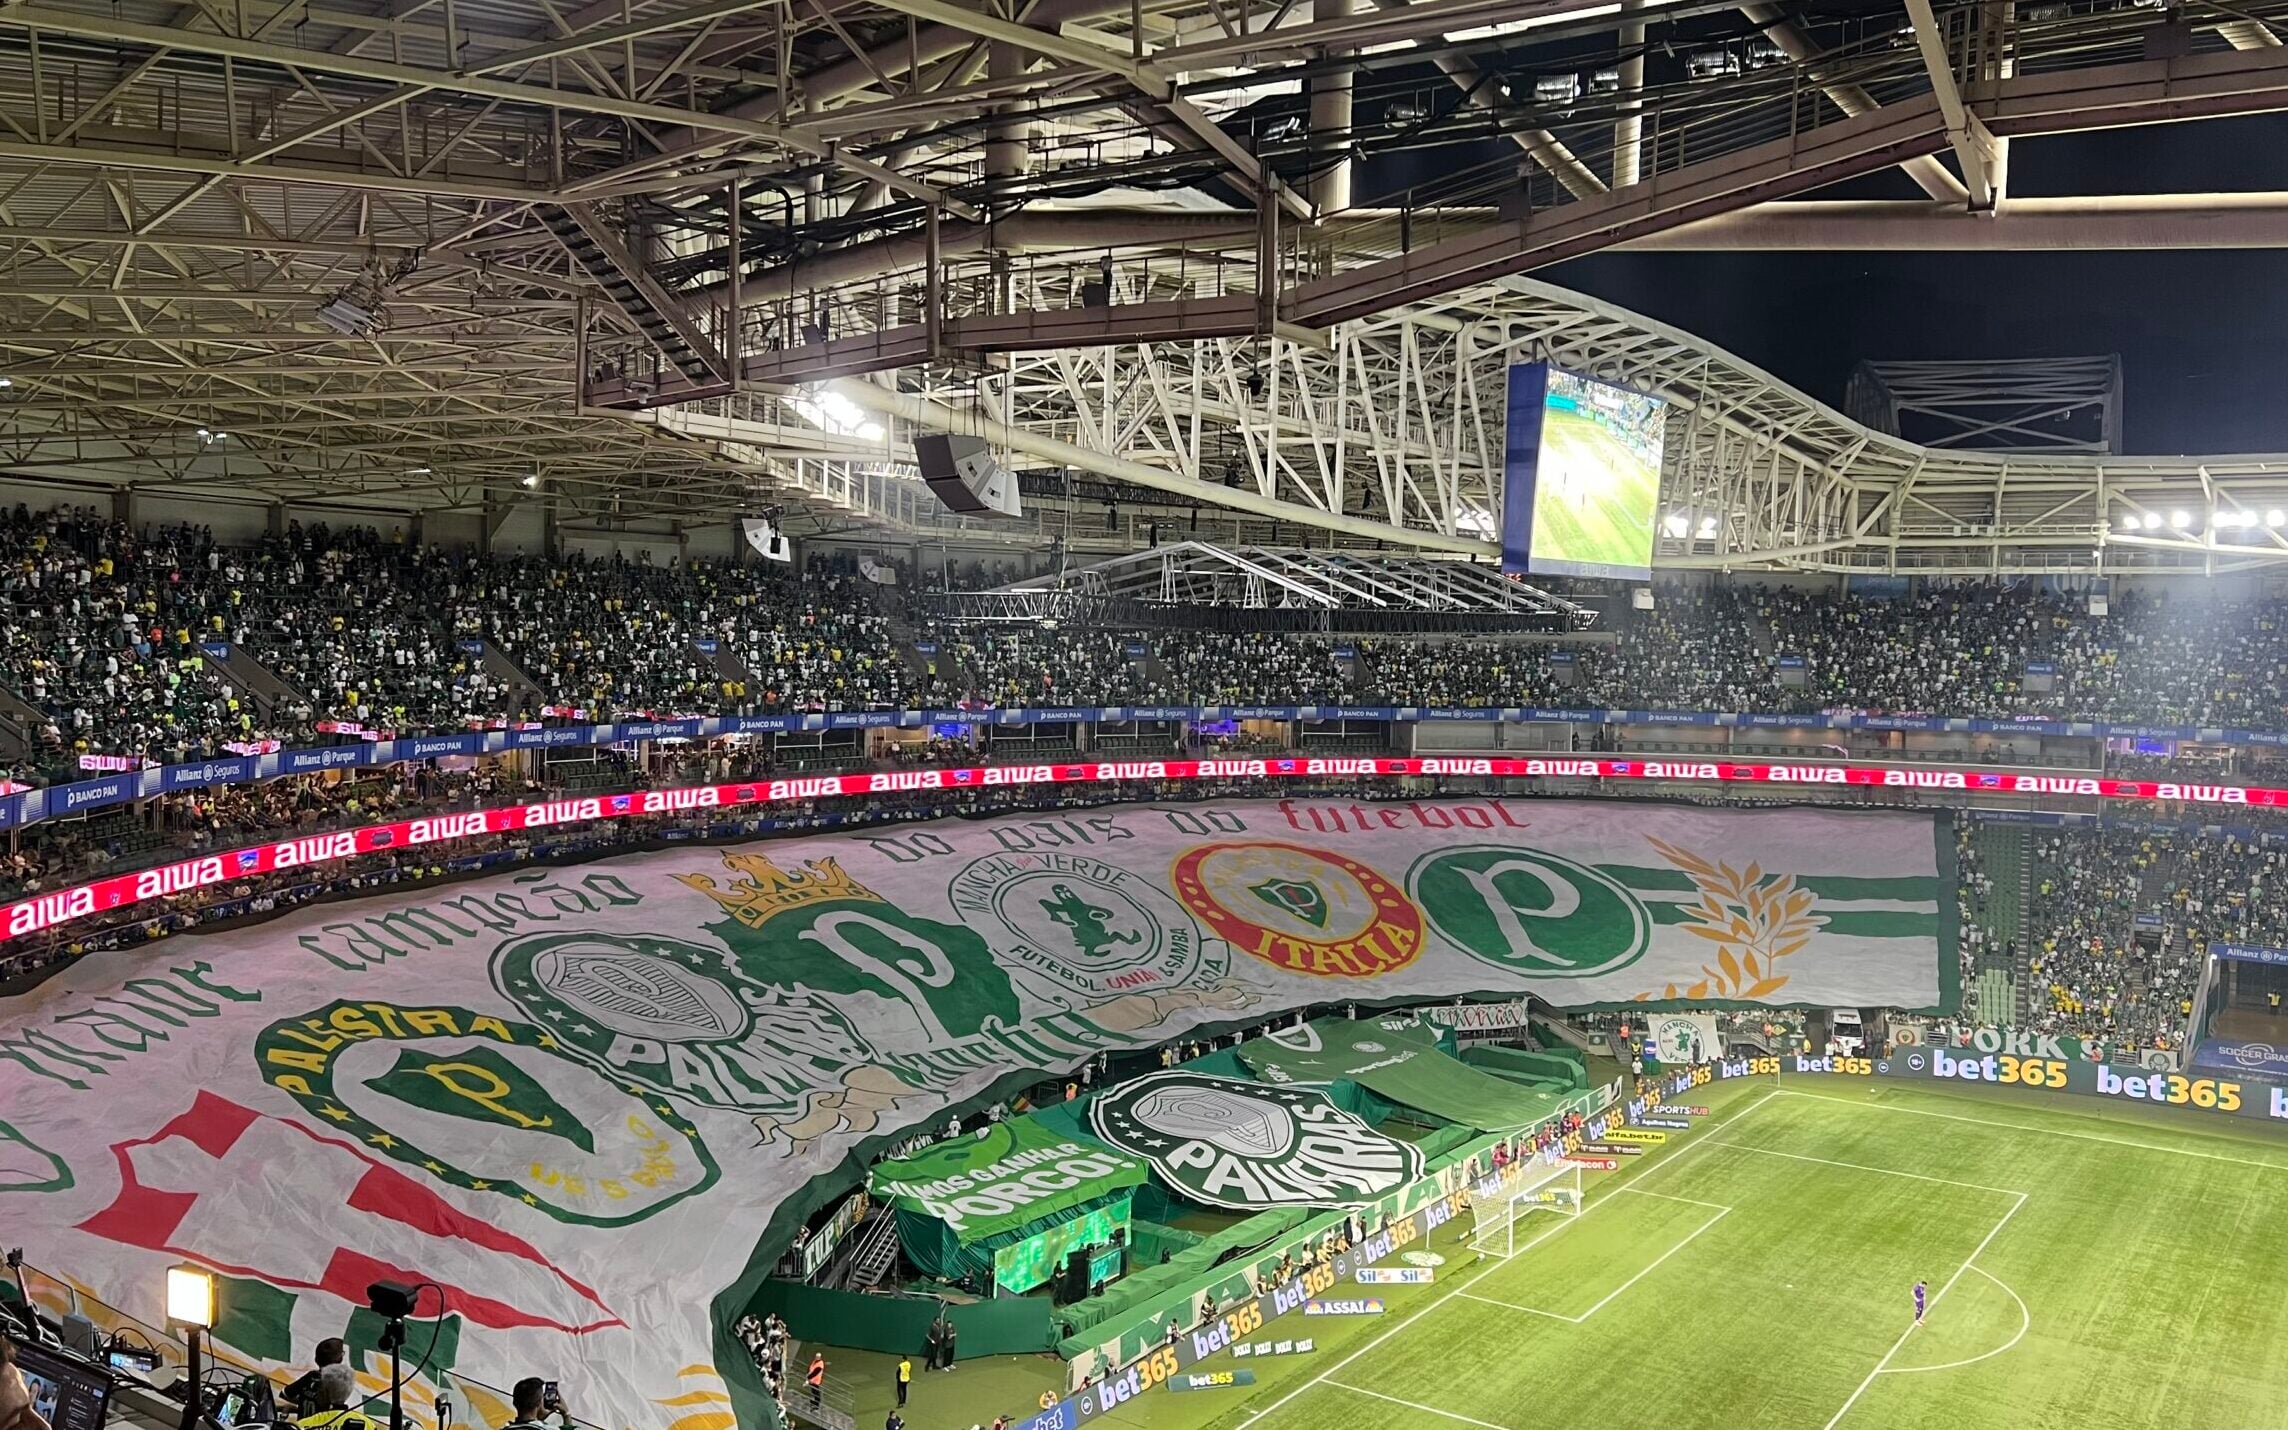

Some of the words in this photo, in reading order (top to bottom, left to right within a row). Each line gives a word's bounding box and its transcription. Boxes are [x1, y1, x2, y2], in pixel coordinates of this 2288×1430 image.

[835, 714, 858, 723] Allianz
[867, 714, 890, 724] Seguros
[935, 711, 958, 721] Allianz
[967, 712, 988, 721] Parque
[1069, 711, 1082, 719] PAN
[1134, 709, 1155, 717] Allianz
[1165, 709, 1187, 718] Seguros
[1233, 708, 1254, 716] Allianz
[1264, 709, 1284, 718] Parque
[1462, 710, 1485, 719] Seguros
[1568, 711, 1590, 719] Parque
[1753, 716, 1777, 724] Allianz
[1787, 717, 1813, 726] Seguros
[628, 724, 652, 736] Allianz
[662, 723, 684, 735] Parque
[746, 721, 769, 729] BANCO
[770, 719, 784, 728] PAN
[1867, 718, 1892, 726] Allianz
[1903, 719, 1927, 728] Parque
[1999, 724, 2023, 732] BANCO
[2110, 726, 2136, 735] Allianz
[2148, 728, 2177, 737] Seguros
[518, 731, 543, 743] Allianz
[553, 730, 577, 742] Seguros
[2248, 733, 2278, 742] Allianz
[421, 742, 445, 753] BANCO
[447, 741, 462, 750] PAN
[294, 753, 321, 766] Allianz
[332, 751, 356, 764] Parque
[1197, 759, 1267, 776] aiwa
[1307, 758, 1377, 774] aiwa
[1421, 758, 1492, 774] aiwa
[1526, 759, 1599, 776] aiwa
[175, 769, 202, 783] Allianz
[214, 764, 240, 778] Seguros
[982, 765, 1052, 784] aiwa
[1096, 761, 1167, 779] aiwa
[1643, 761, 1720, 779] aiwa
[1768, 765, 1847, 782] aiwa
[1884, 770, 1967, 788] aiwa
[769, 776, 842, 799] aiwa
[870, 770, 943, 791] aiwa
[2015, 776, 2100, 795] aiwa
[75, 789, 101, 802] BANCO
[102, 784, 118, 797] PAN
[643, 787, 721, 812] aiwa
[2156, 783, 2247, 803] aiwa
[524, 798, 601, 827] aiwa
[1279, 799, 1531, 833] futebol
[408, 812, 488, 844] aiwa
[273, 830, 357, 869] aiwa
[136, 857, 223, 900] aiwa
[956, 857, 1018, 915] MANCHA
[1031, 854, 1132, 886] VERDE
[9, 887, 95, 935] aiwa
[1165, 928, 1189, 969] SAMBA
[2226, 948, 2259, 959] Allianz
[1662, 1021, 1699, 1037] MANCHA
[266, 1003, 515, 1096] PALESTRA
[2218, 1046, 2263, 1060] SOCCER
[1722, 1057, 1780, 1079] bet365
[1797, 1056, 1873, 1076] bet365
[1934, 1049, 2068, 1089] bet365
[1676, 1066, 1712, 1094] bet365
[2096, 1065, 2242, 1112] bet365
[1628, 1088, 1661, 1118] bet365
[1588, 1108, 1625, 1142] bet365
[1543, 1131, 1583, 1166] bet365
[970, 1141, 1090, 1182] GANHAR
[919, 1151, 1137, 1232] PORCO!
[1425, 1189, 1471, 1229] bet365
[1364, 1217, 1417, 1264] bet365
[1359, 1269, 1377, 1281] Sil
[1401, 1269, 1418, 1281] Sil
[1273, 1261, 1335, 1316] bet365
[1193, 1302, 1263, 1361] bet365
[1098, 1346, 1180, 1412] bet365
[1189, 1372, 1233, 1387] bet365
